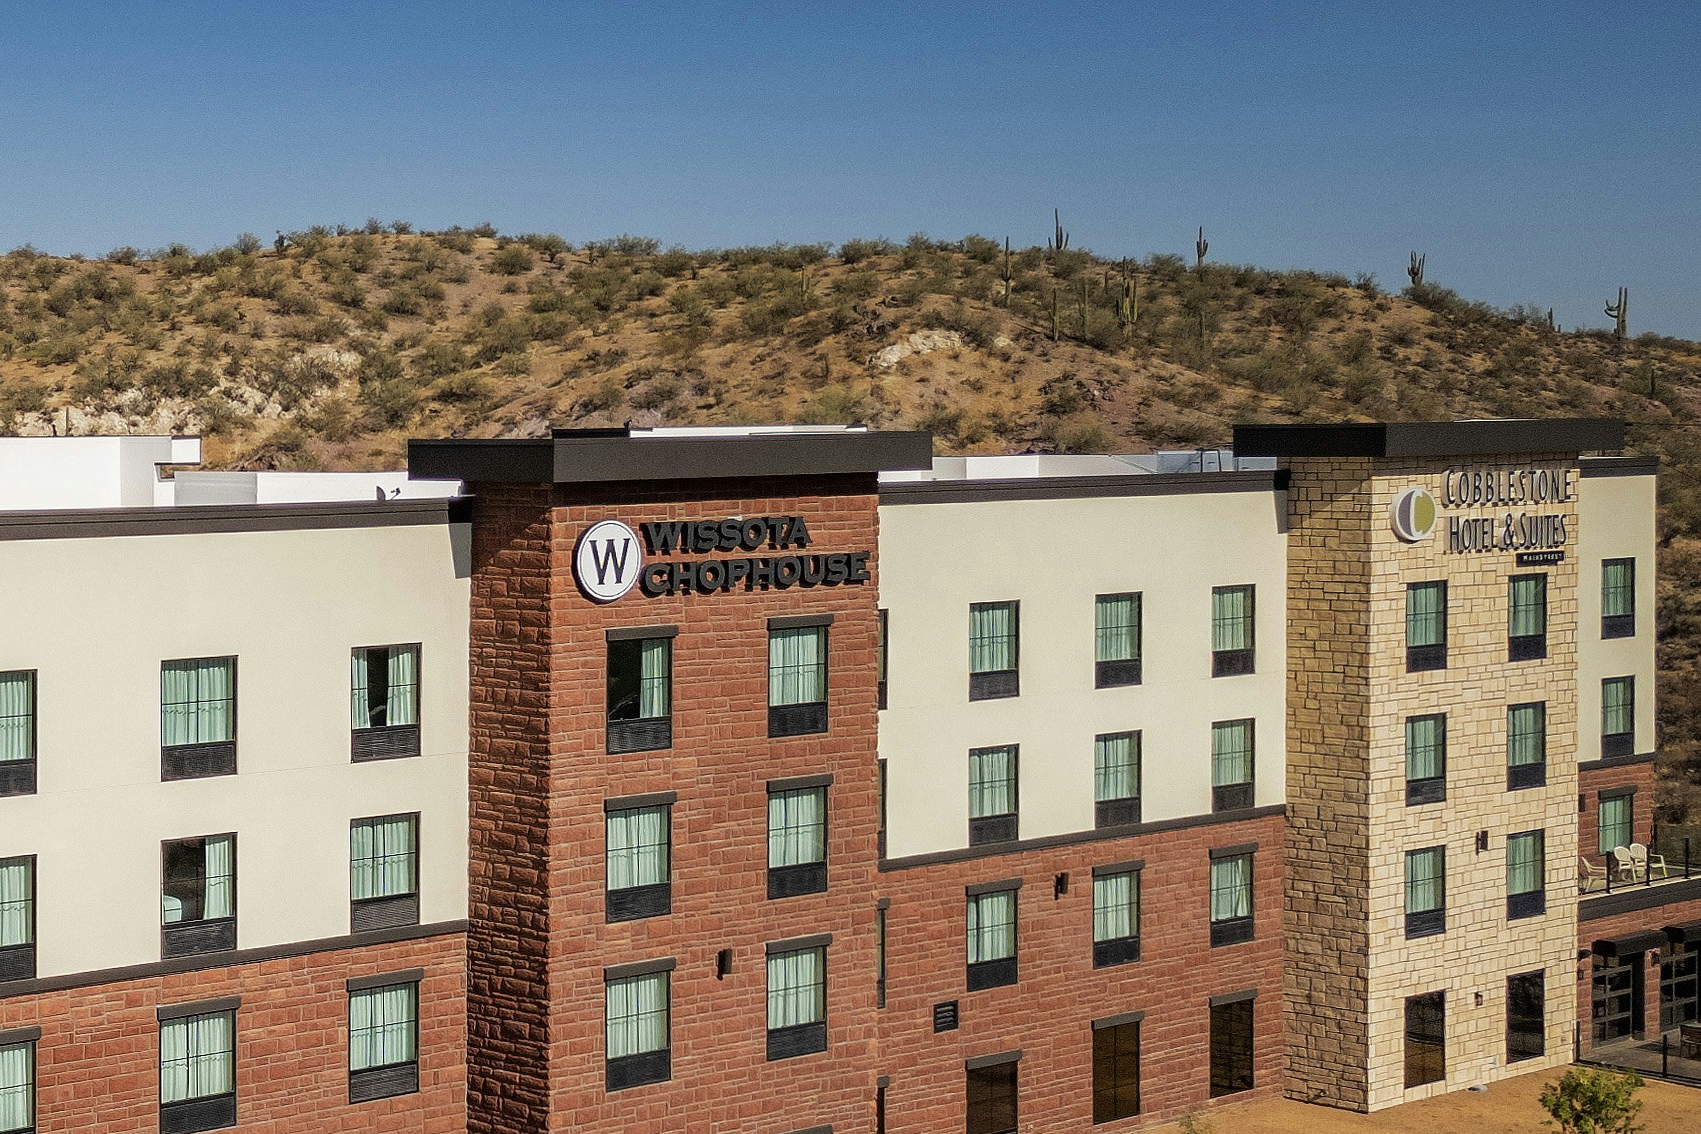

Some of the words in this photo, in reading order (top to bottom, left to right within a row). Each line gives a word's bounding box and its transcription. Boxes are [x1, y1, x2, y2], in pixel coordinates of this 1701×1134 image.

[1445, 469, 1572, 504] COBBLESTONE
[646, 516, 812, 550] WISSOTA
[1448, 515, 1498, 551] HOTEL
[1502, 512, 1515, 548] &
[1518, 512, 1568, 548] SUITES
[588, 538, 630, 586] W
[645, 551, 871, 593] CHOPHOUSE
